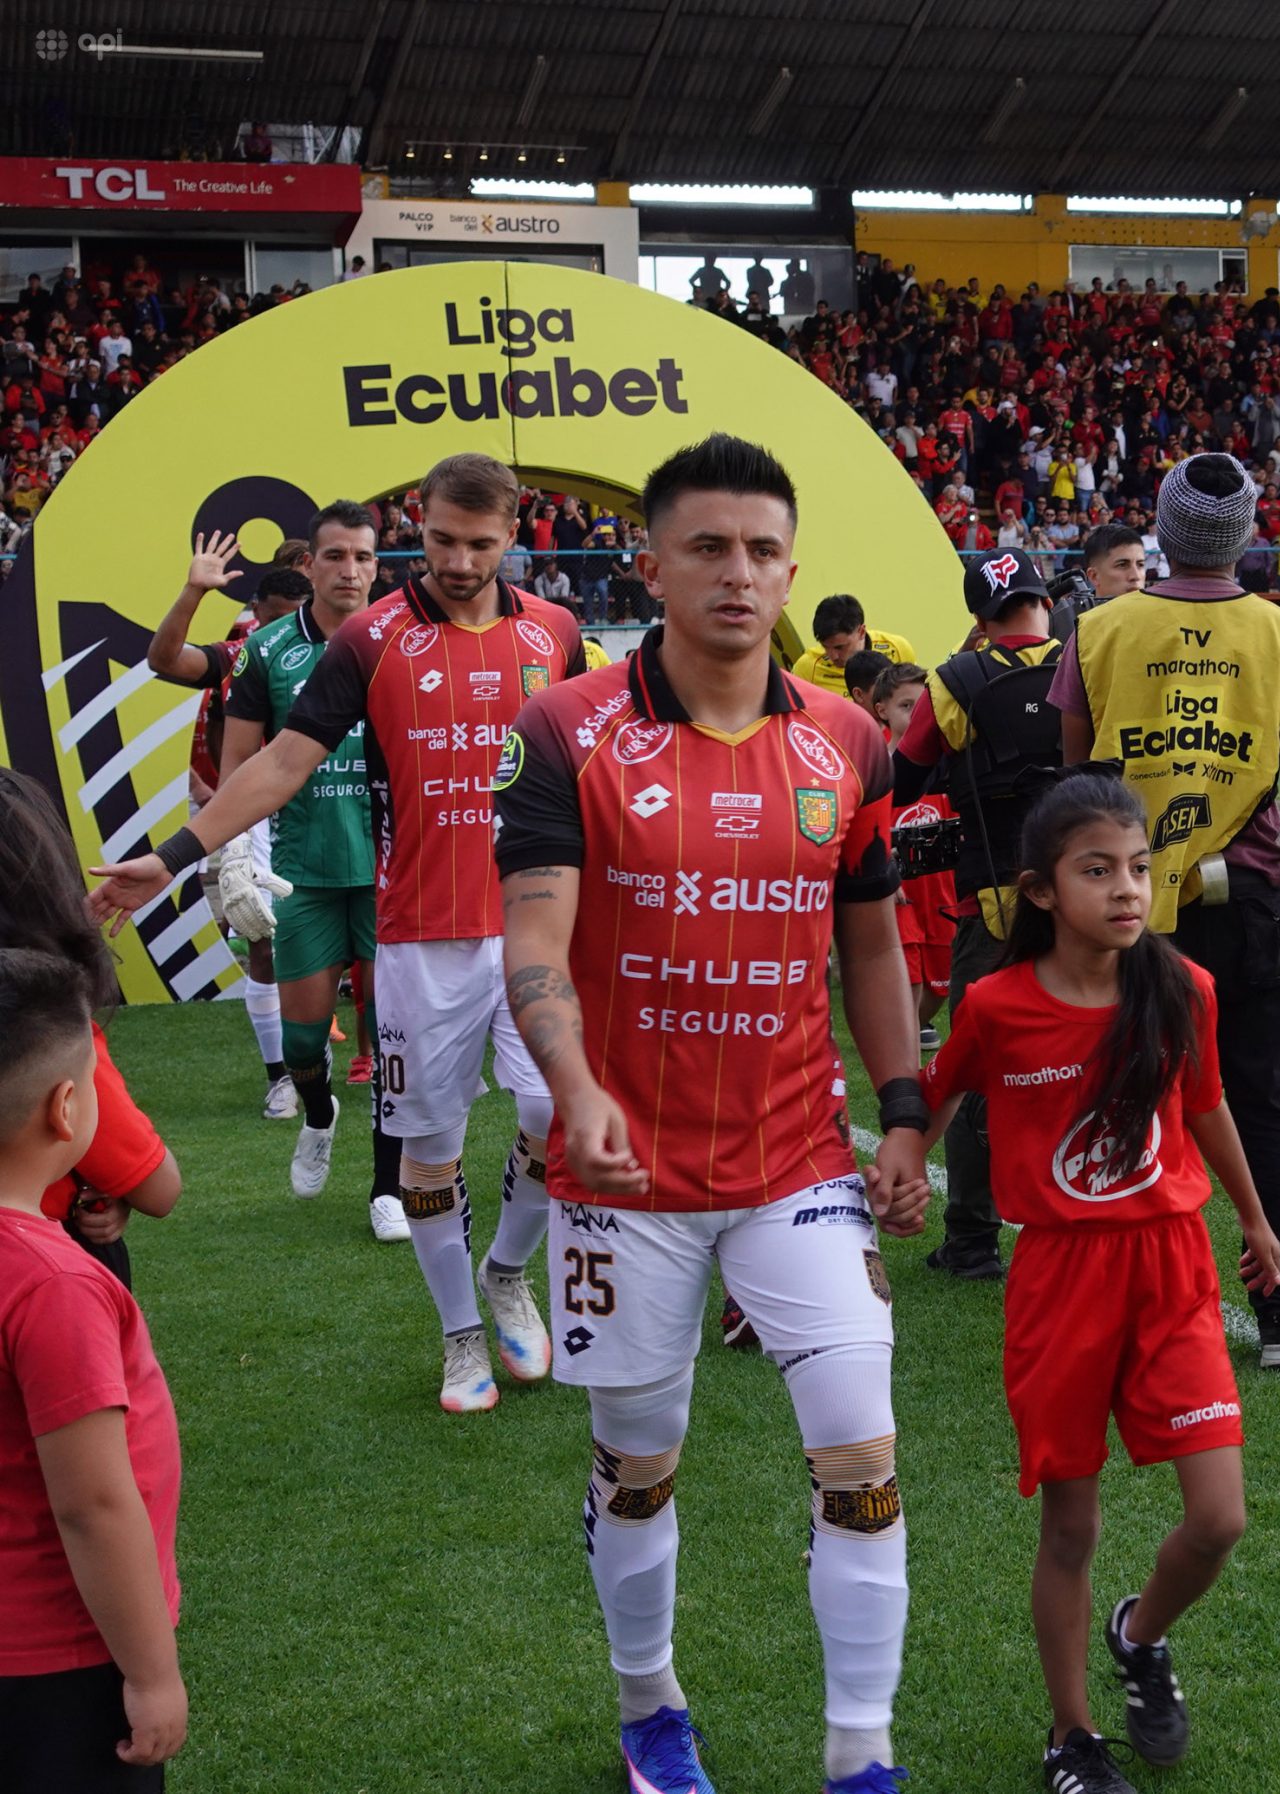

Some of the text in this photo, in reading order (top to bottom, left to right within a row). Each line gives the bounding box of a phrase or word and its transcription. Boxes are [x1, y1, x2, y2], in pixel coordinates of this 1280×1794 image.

[56, 167, 165, 200] TCL
[174, 179, 273, 194] The Creative Life
[399, 212, 433, 222] PALCO
[450, 214, 477, 223] banco
[496, 216, 560, 234] austro
[416, 223, 434, 231] VIP
[464, 222, 477, 231] del
[445, 297, 575, 357] Liga
[342, 357, 688, 427] Ecuabet
[1180, 627, 1211, 648] TV
[471, 673, 499, 681] metrocar
[1147, 660, 1240, 678] marathon
[1025, 703, 1039, 713] RG
[1166, 690, 1218, 720] Liga
[408, 728, 447, 741] banco
[622, 724, 668, 759] EUROPEA
[626, 727, 645, 740] LA
[1119, 721, 1253, 762] Ecuabet
[428, 739, 448, 750] del
[423, 776, 495, 796] CHU
[714, 795, 757, 806] metrocar
[437, 809, 493, 826] SEGU
[607, 866, 666, 890] banco
[635, 890, 665, 908] del
[709, 875, 828, 913] austro
[620, 953, 809, 985] CHUBB
[1003, 1064, 1083, 1087] marathon
[564, 1247, 615, 1317] 25
